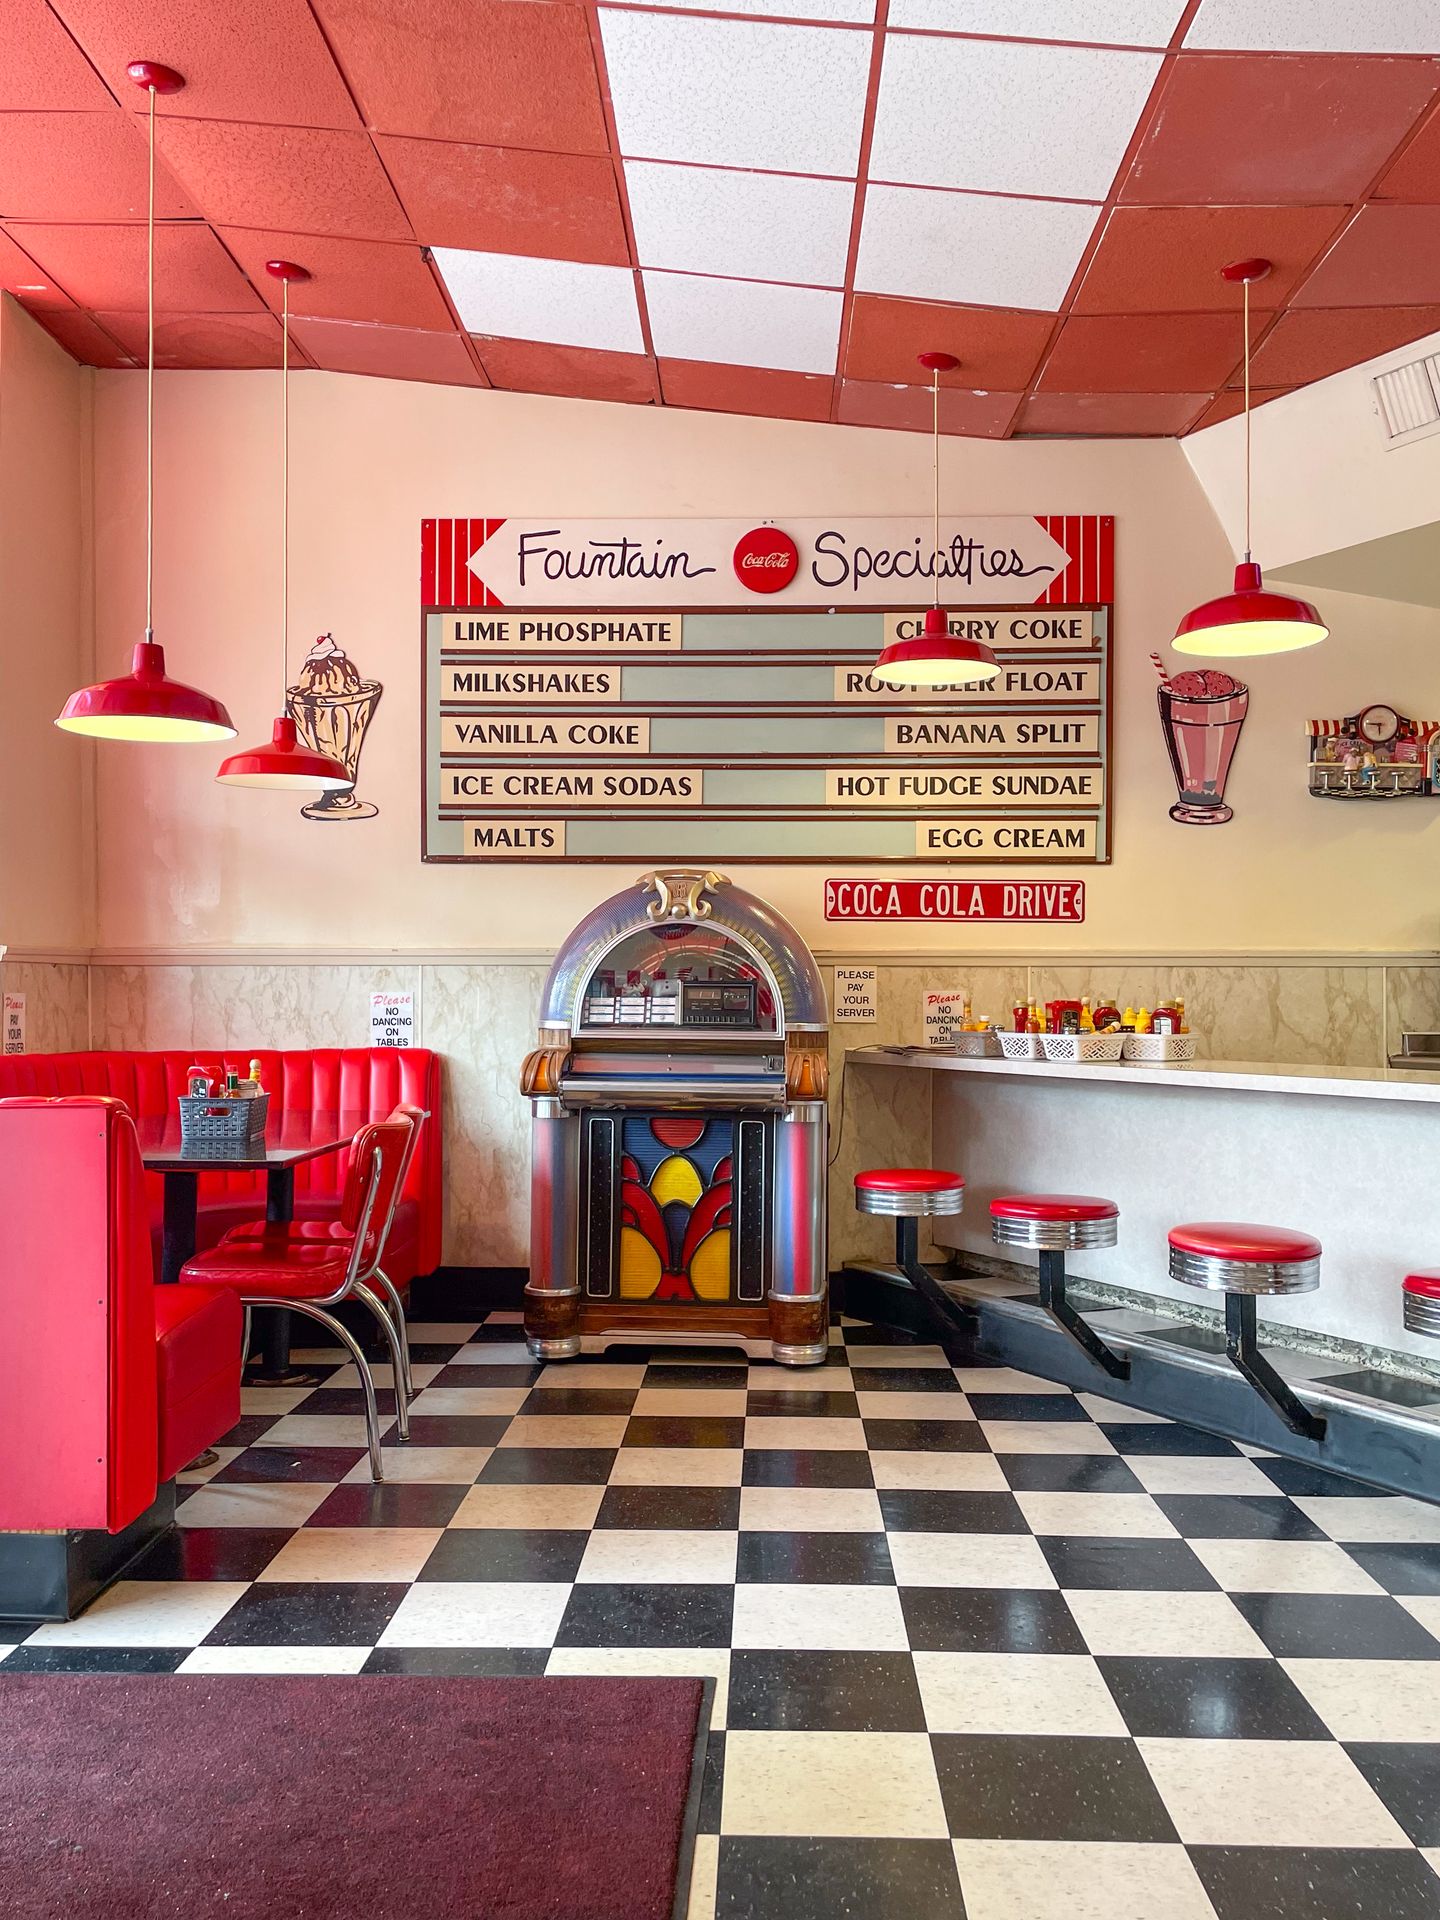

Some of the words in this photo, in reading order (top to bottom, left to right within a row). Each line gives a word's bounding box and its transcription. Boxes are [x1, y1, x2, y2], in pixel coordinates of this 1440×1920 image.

[518, 530, 716, 586] Fountain
[741, 551, 791, 569] Coca-Cola
[812, 531, 1055, 591] Specialties
[456, 622, 509, 640] LIME
[520, 623, 671, 641] PHOSPHATE
[895, 620, 1000, 640] CHRRY
[1010, 620, 1082, 639] COKE
[454, 673, 609, 693] MILKSHAKES
[1006, 672, 1087, 691] FLOAT
[455, 725, 558, 743] VANILLA
[569, 725, 638, 744] COKE
[898, 725, 1005, 743] BANANA
[1017, 724, 1086, 743] SPLIT
[454, 776, 493, 795] ICE
[504, 776, 592, 795] CREAM
[604, 777, 691, 796] SODAS
[838, 777, 890, 795] HOT
[900, 776, 982, 795] FUDGE
[993, 776, 1091, 795] SUNDAE
[475, 828, 554, 847] MALTS
[929, 829, 983, 847] EGG
[994, 829, 1084, 847] CREAM
[837, 884, 902, 915] COCA
[919, 885, 985, 916] COLA
[1003, 886, 1072, 917] DRIVE
[837, 970, 875, 980] PLEASE
[847, 983, 865, 992] PAY
[373, 994, 411, 1007] Please
[842, 995, 870, 1005] YOUR
[927, 993, 961, 1006] Please
[385, 1007, 399, 1016] NO
[836, 1008, 875, 1017] SERVER
[938, 1005, 952, 1015] NO
[372, 1017, 412, 1026] DANCING
[926, 1015, 965, 1025] DANCING
[8, 1028, 22, 1040] YOUR
[385, 1027, 399, 1037] ON
[938, 1025, 953, 1035] ON
[375, 1037, 409, 1047] TABLES
